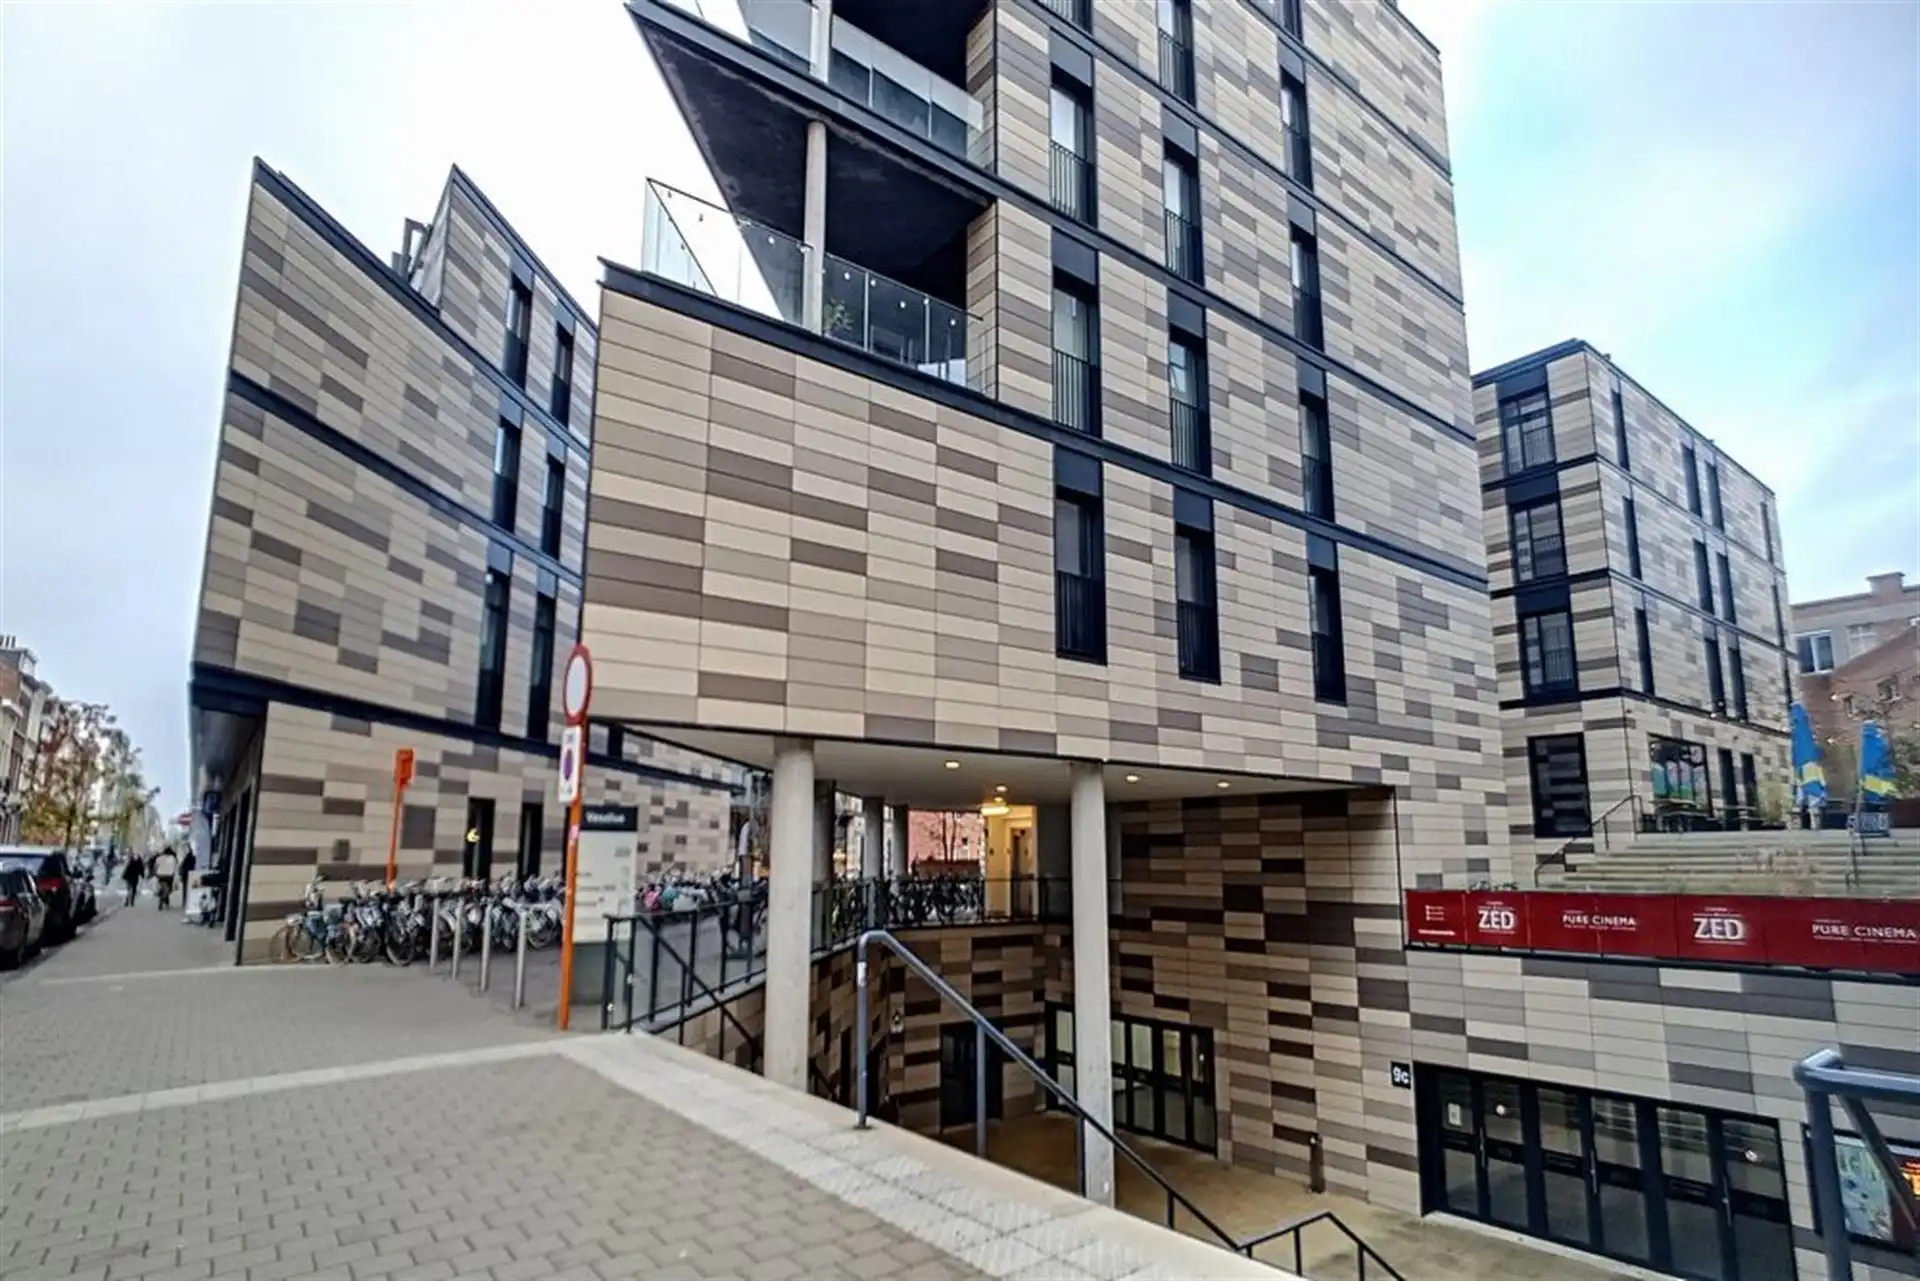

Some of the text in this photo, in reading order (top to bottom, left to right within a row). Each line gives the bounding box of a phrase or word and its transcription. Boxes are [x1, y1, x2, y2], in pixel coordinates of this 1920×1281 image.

[1478, 909, 1516, 930] ZED
[1562, 914, 1637, 926] PURE CINEMA
[1693, 917, 1745, 940] ZED
[1812, 923, 1917, 938] PURE CINEMA
[1393, 1066, 1409, 1084] 9c
